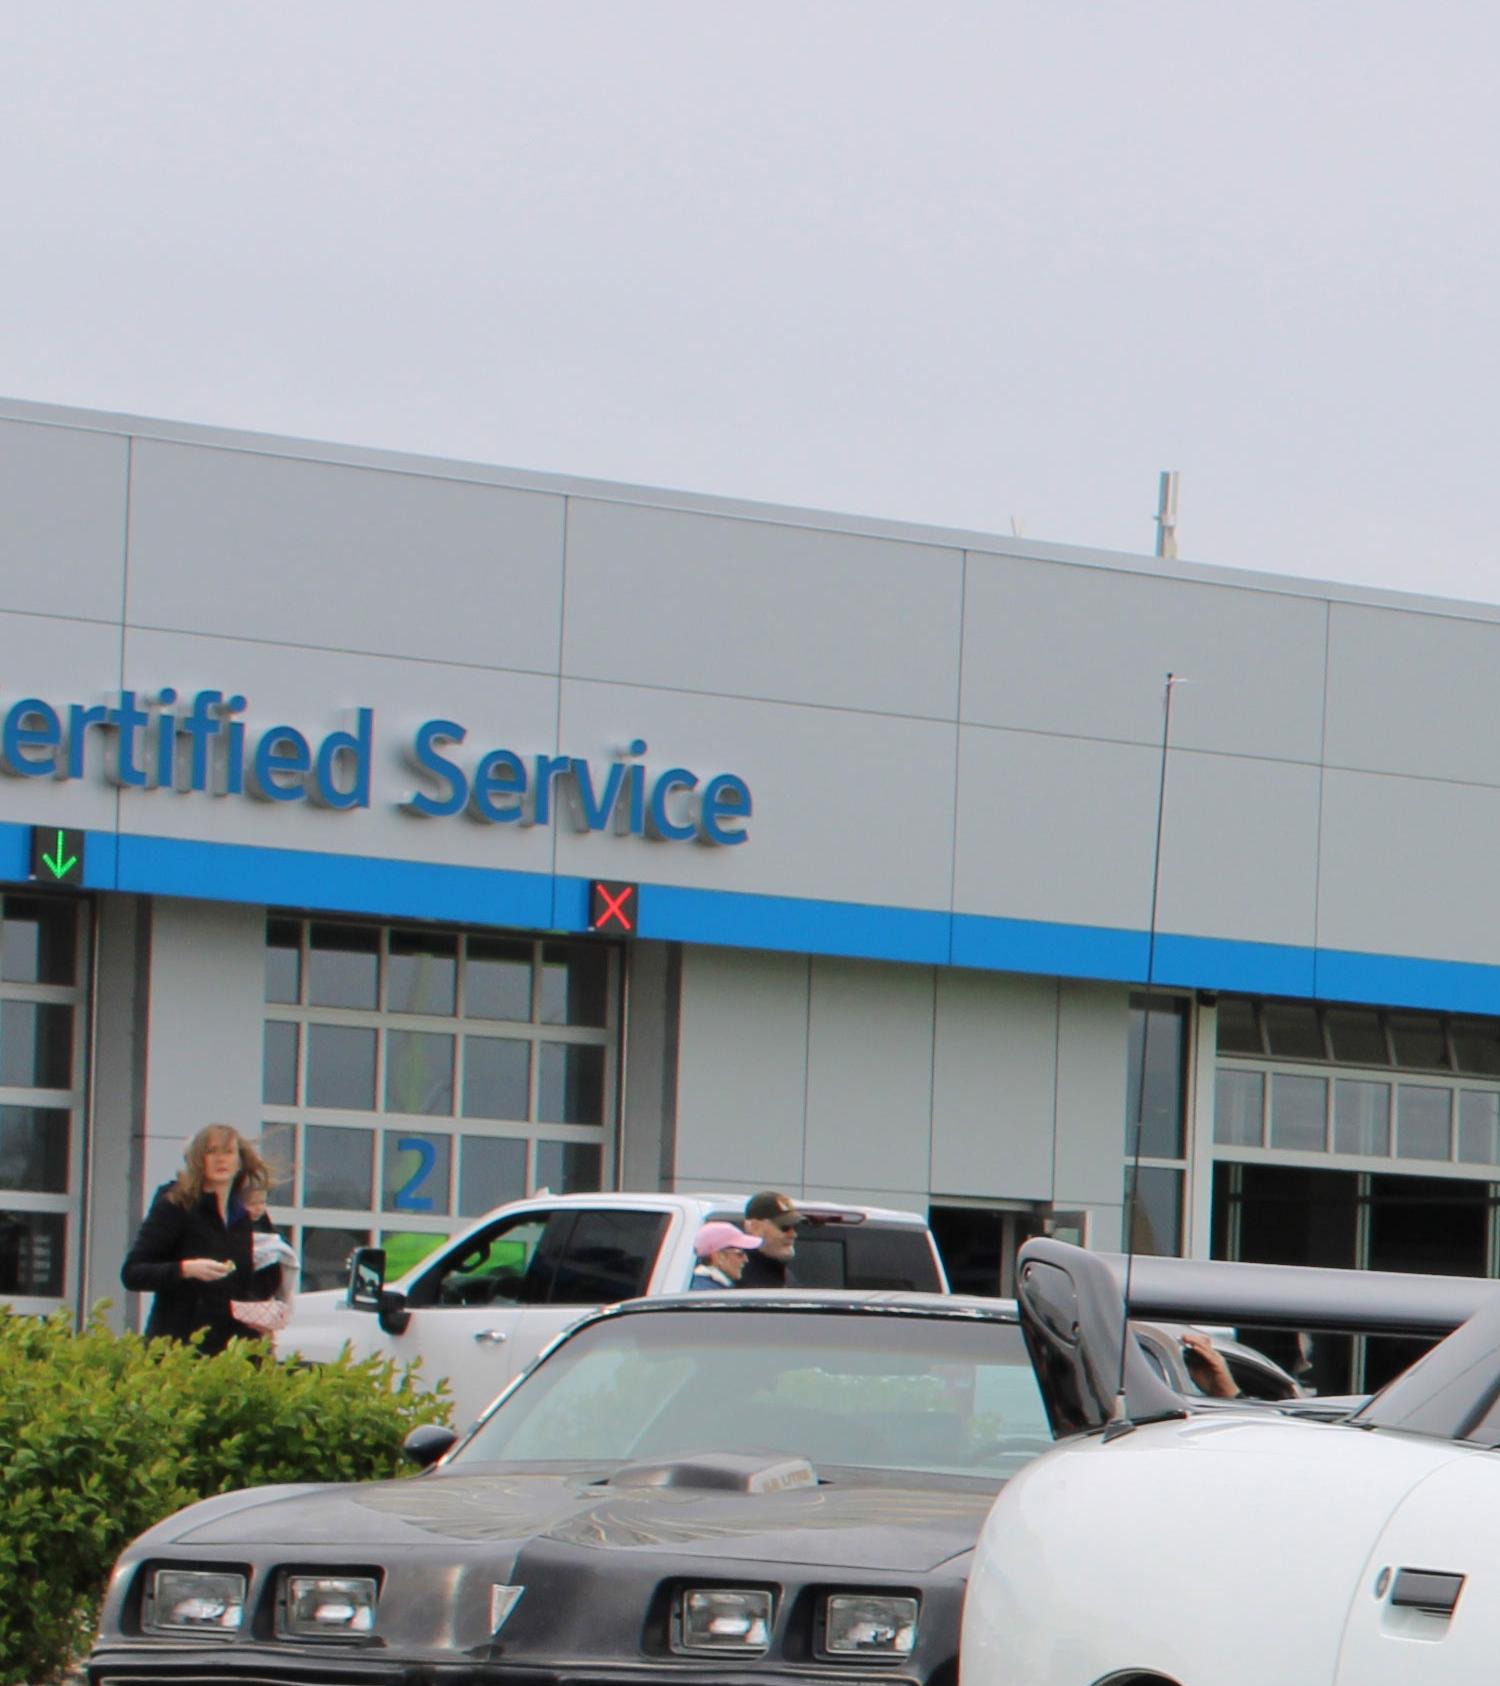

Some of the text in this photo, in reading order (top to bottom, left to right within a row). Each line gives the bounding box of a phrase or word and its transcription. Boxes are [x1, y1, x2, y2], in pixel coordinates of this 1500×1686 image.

[2, 686, 752, 846] ertified Service
[394, 1137, 437, 1212] 2
